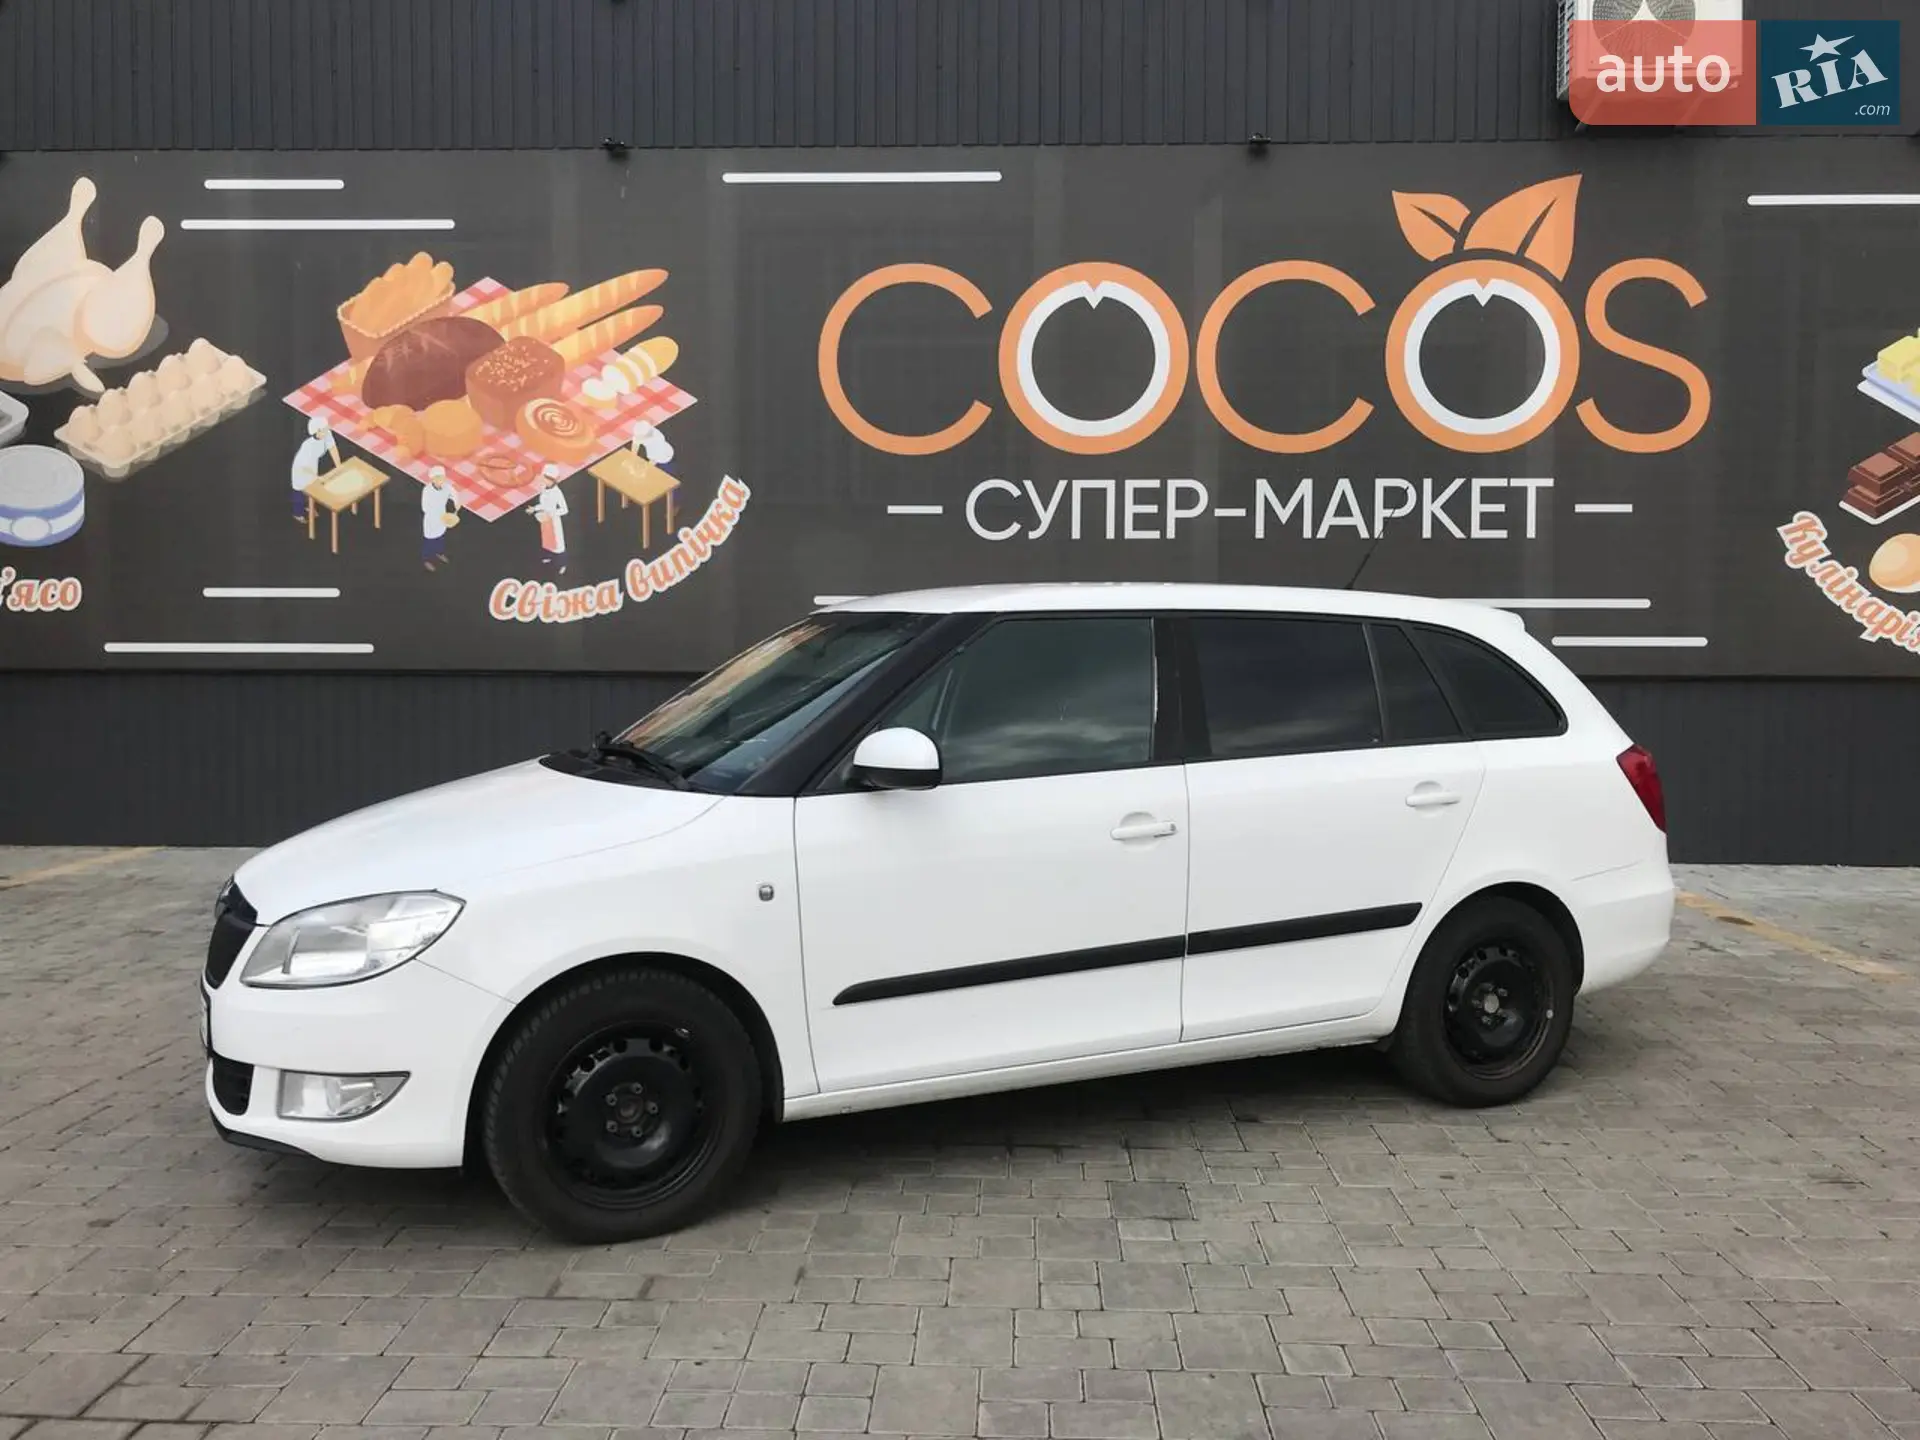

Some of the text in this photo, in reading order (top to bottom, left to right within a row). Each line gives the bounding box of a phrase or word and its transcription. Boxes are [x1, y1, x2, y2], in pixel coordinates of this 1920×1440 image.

[817, 257, 1712, 456] COCOS
[489, 474, 751, 624] Свіжа випічка
[965, 477, 1554, 541] СУПЕР-МАРКЕТ
[0, 566, 82, 612] 'ясо
